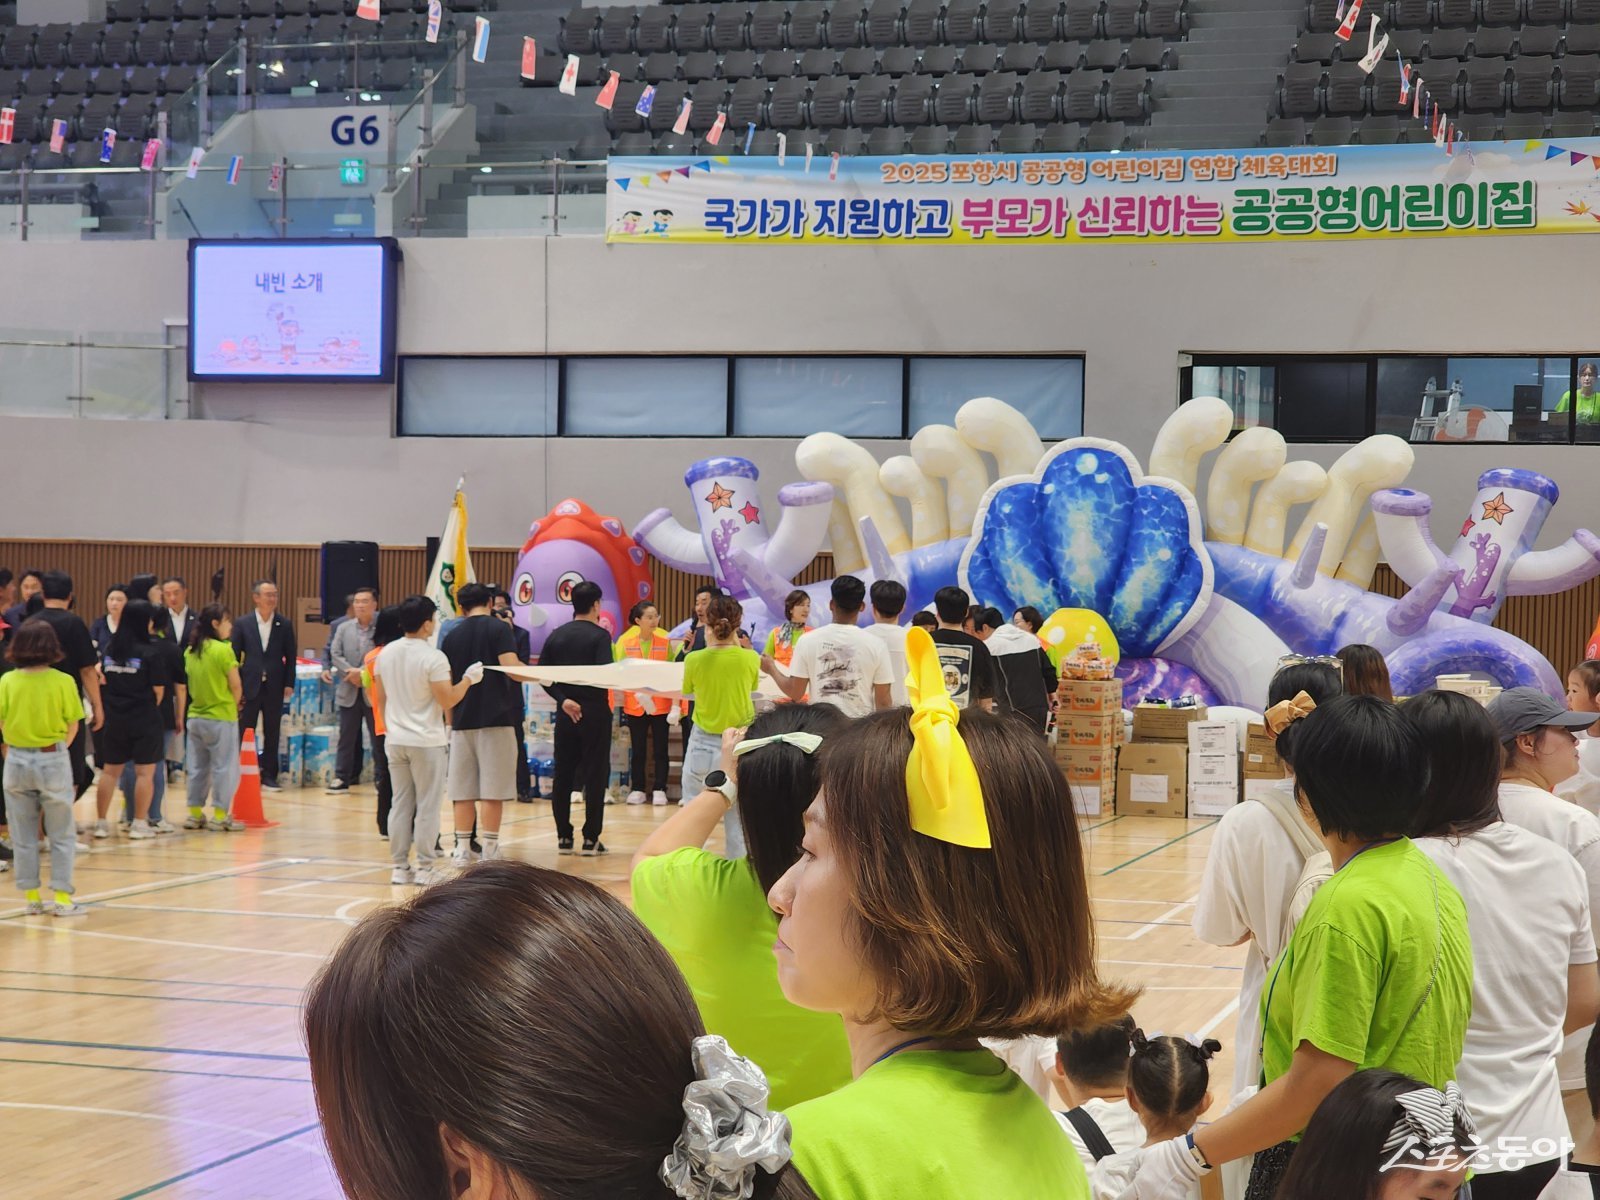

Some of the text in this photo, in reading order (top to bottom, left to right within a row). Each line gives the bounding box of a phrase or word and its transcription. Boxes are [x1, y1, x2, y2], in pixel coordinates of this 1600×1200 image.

[331, 115, 379, 145] G6
[880, 154, 1337, 182] 2025 포항시 공공형 어린이집 연합 체육대회
[704, 181, 1537, 236] 국가가 지원하고 부모가 신뢰하는 공공형어린이집
[255, 272, 323, 293] 내빈 소개
